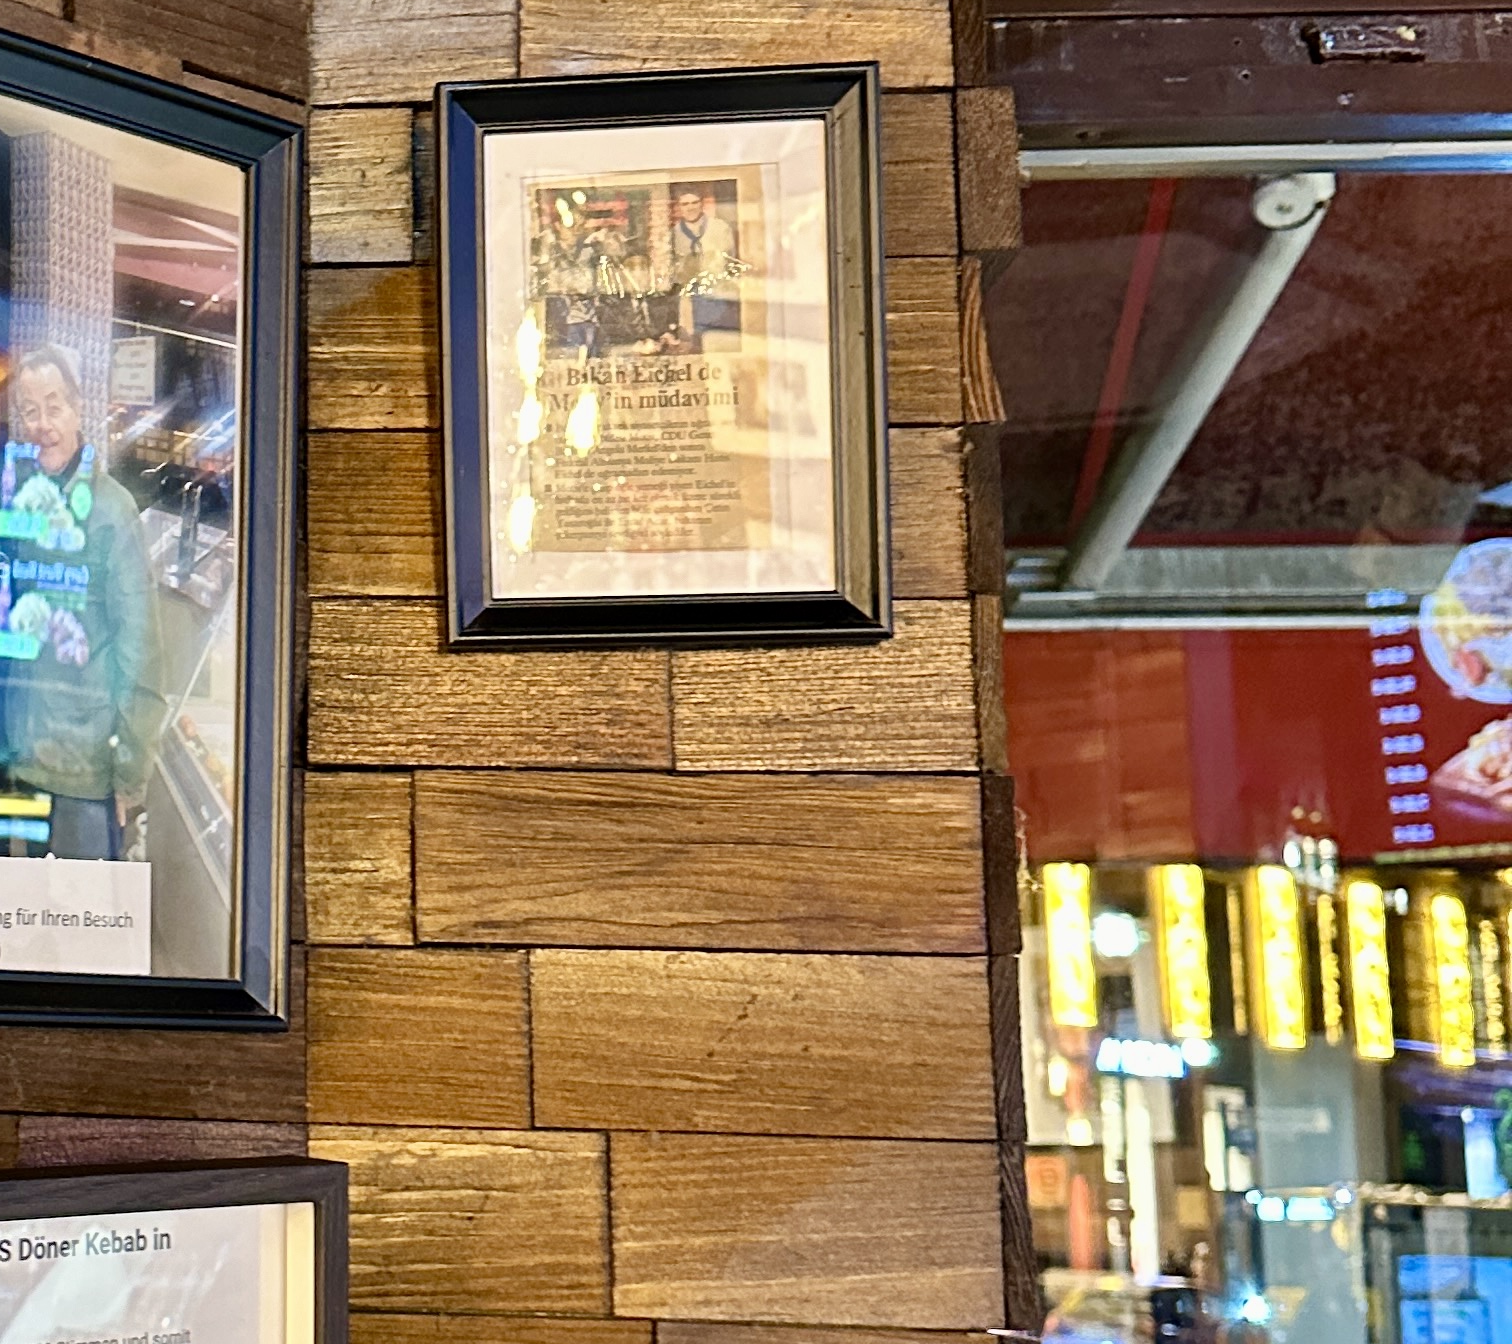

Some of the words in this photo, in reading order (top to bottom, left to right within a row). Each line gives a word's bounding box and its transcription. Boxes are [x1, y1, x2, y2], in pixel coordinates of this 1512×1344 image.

[632, 363, 692, 384] Eichel
[698, 363, 722, 380] de
[640, 386, 739, 409] müdavimi
[16, 907, 40, 926] für
[42, 910, 80, 927] Ihren
[83, 911, 134, 929] Besuch
[18, 1236, 79, 1261] Döner
[86, 1228, 148, 1256] Kebab
[153, 1227, 171, 1251] in
